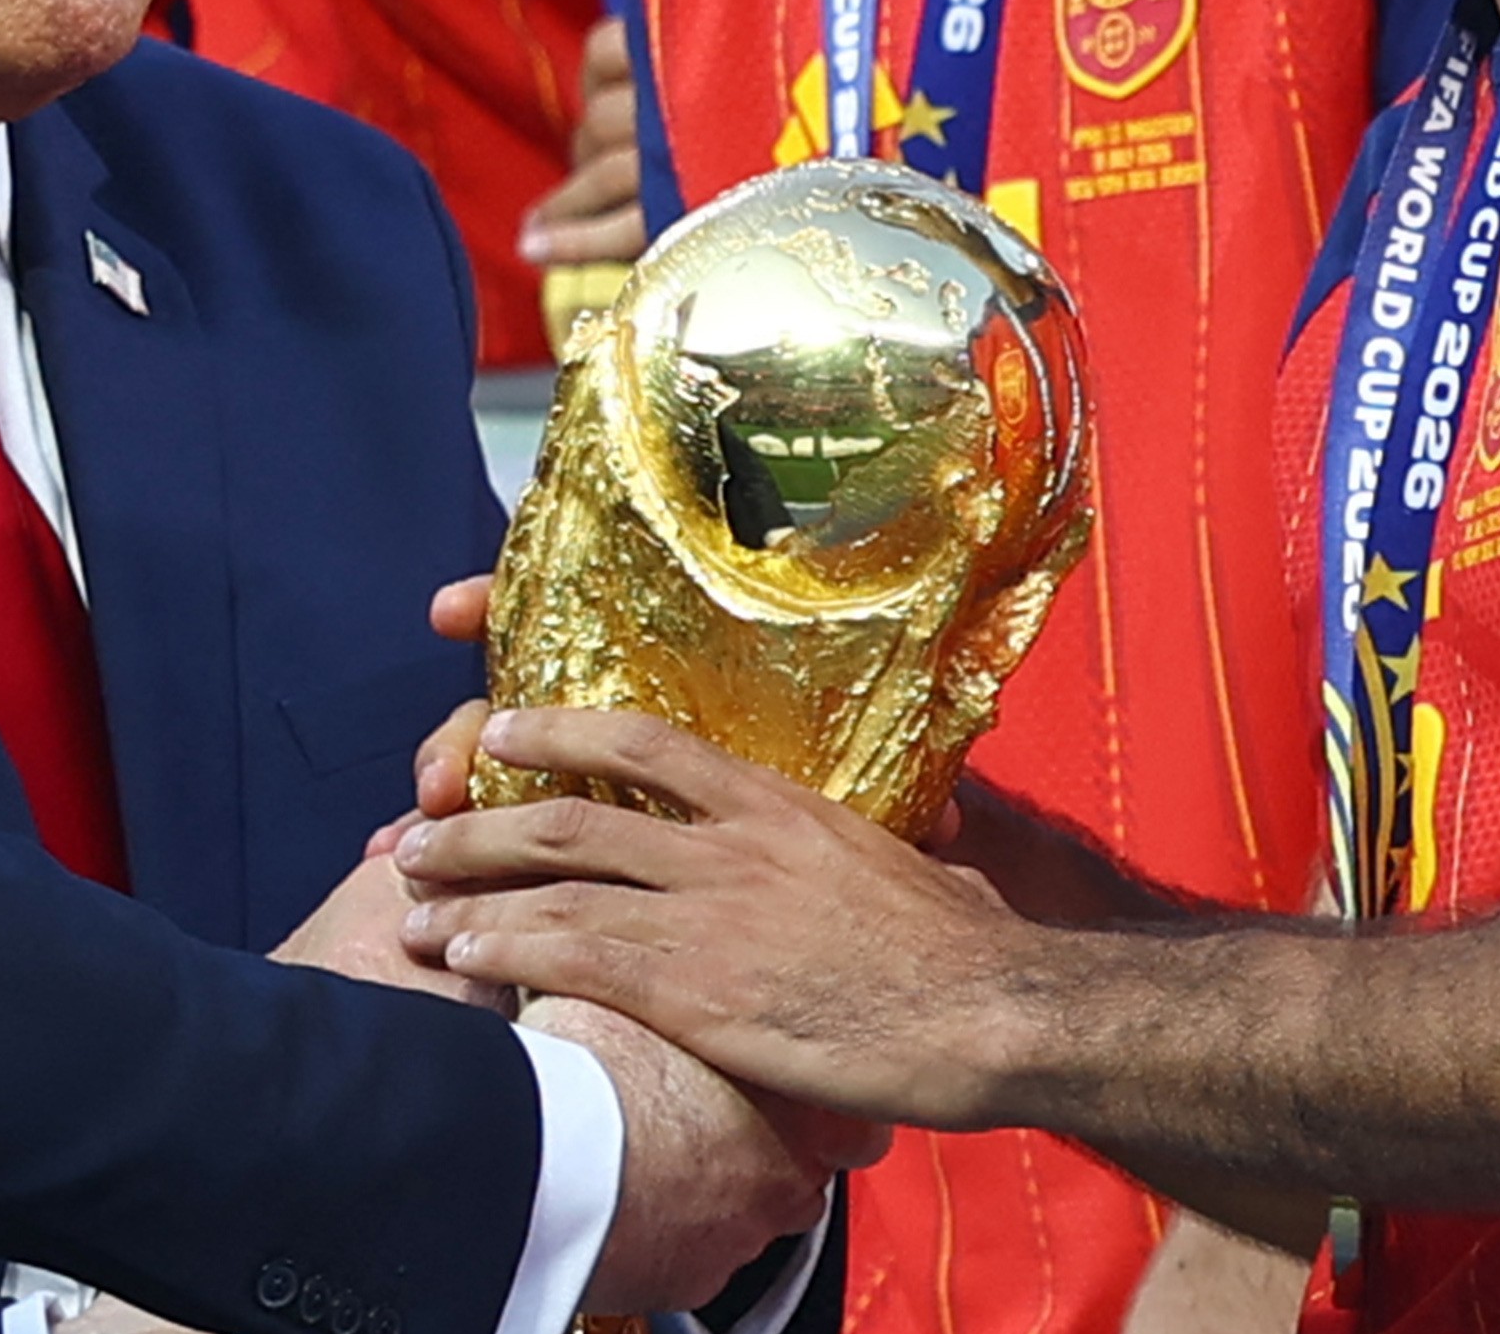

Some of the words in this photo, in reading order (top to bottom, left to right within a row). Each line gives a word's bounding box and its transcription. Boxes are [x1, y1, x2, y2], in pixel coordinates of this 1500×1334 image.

[1423, 29, 1480, 134] FIFA
[1371, 145, 1447, 331] WORLD
[1354, 336, 1406, 442] CUP
[1403, 320, 1472, 511] 2026
